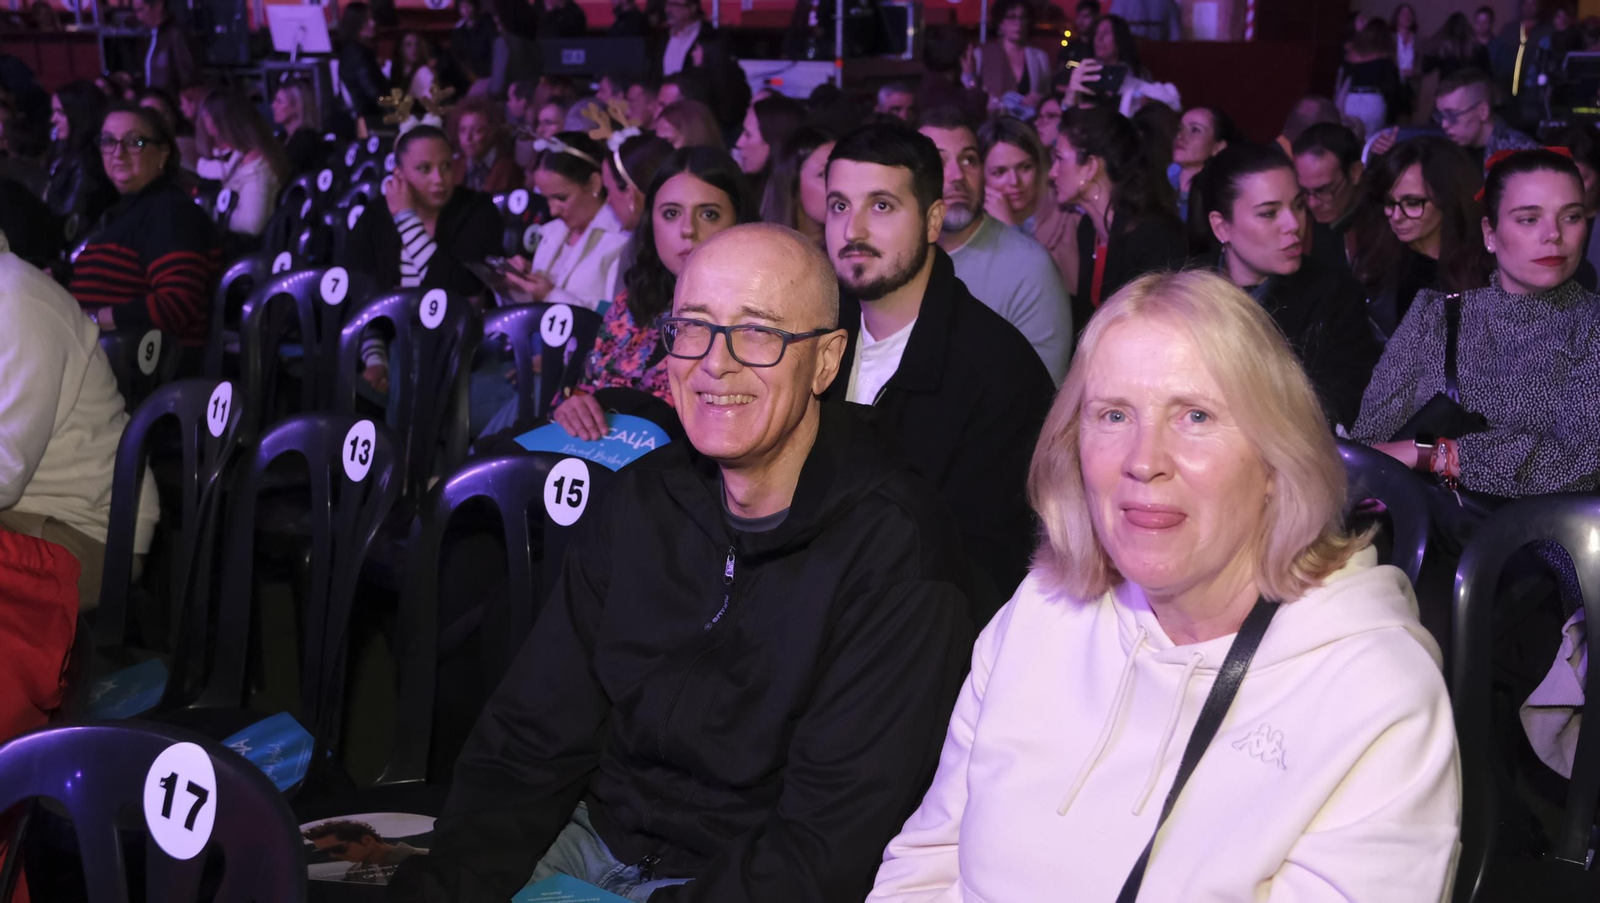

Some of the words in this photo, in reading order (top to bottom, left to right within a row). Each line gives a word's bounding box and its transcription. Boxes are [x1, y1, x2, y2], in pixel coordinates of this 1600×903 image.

[331, 278, 340, 293] 7
[428, 300, 438, 316] 9
[548, 314, 568, 336] 11
[145, 342, 155, 361] 9
[213, 397, 228, 423] 11
[350, 435, 371, 466] 13
[553, 475, 585, 508] 15
[159, 771, 210, 832] 17
